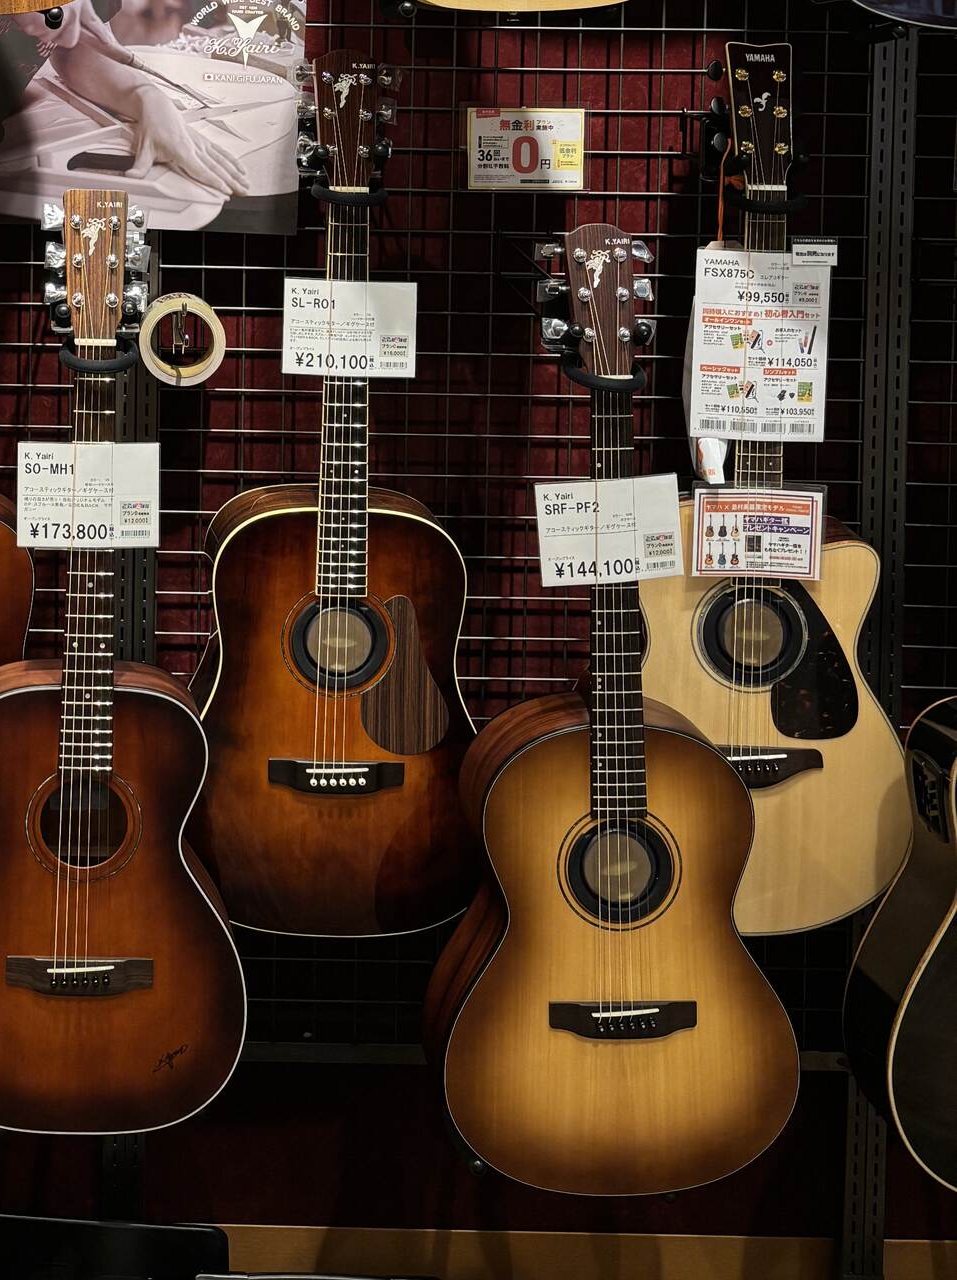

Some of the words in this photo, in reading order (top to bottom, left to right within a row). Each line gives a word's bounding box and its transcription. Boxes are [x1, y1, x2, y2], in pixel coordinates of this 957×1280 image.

[190, 1, 218, 26] WORLD
[275, 4, 300, 31] BRAND
[745, 53, 776, 62] YAMAHA
[499, 120, 534, 131] 無金利
[704, 258, 740, 266] YAMAHA
[704, 268, 754, 279] FSX875C
[737, 290, 785, 304] ¥99,550
[295, 352, 368, 370] ¥210,100
[768, 357, 813, 368] ¥114,050
[36, 452, 54, 460] Yairi
[24, 463, 74, 475] SO-MH1
[545, 501, 600, 515] SRF-PF2
[30, 523, 108, 539] ¥173,800
[555, 558, 633, 578] ¥144,100
